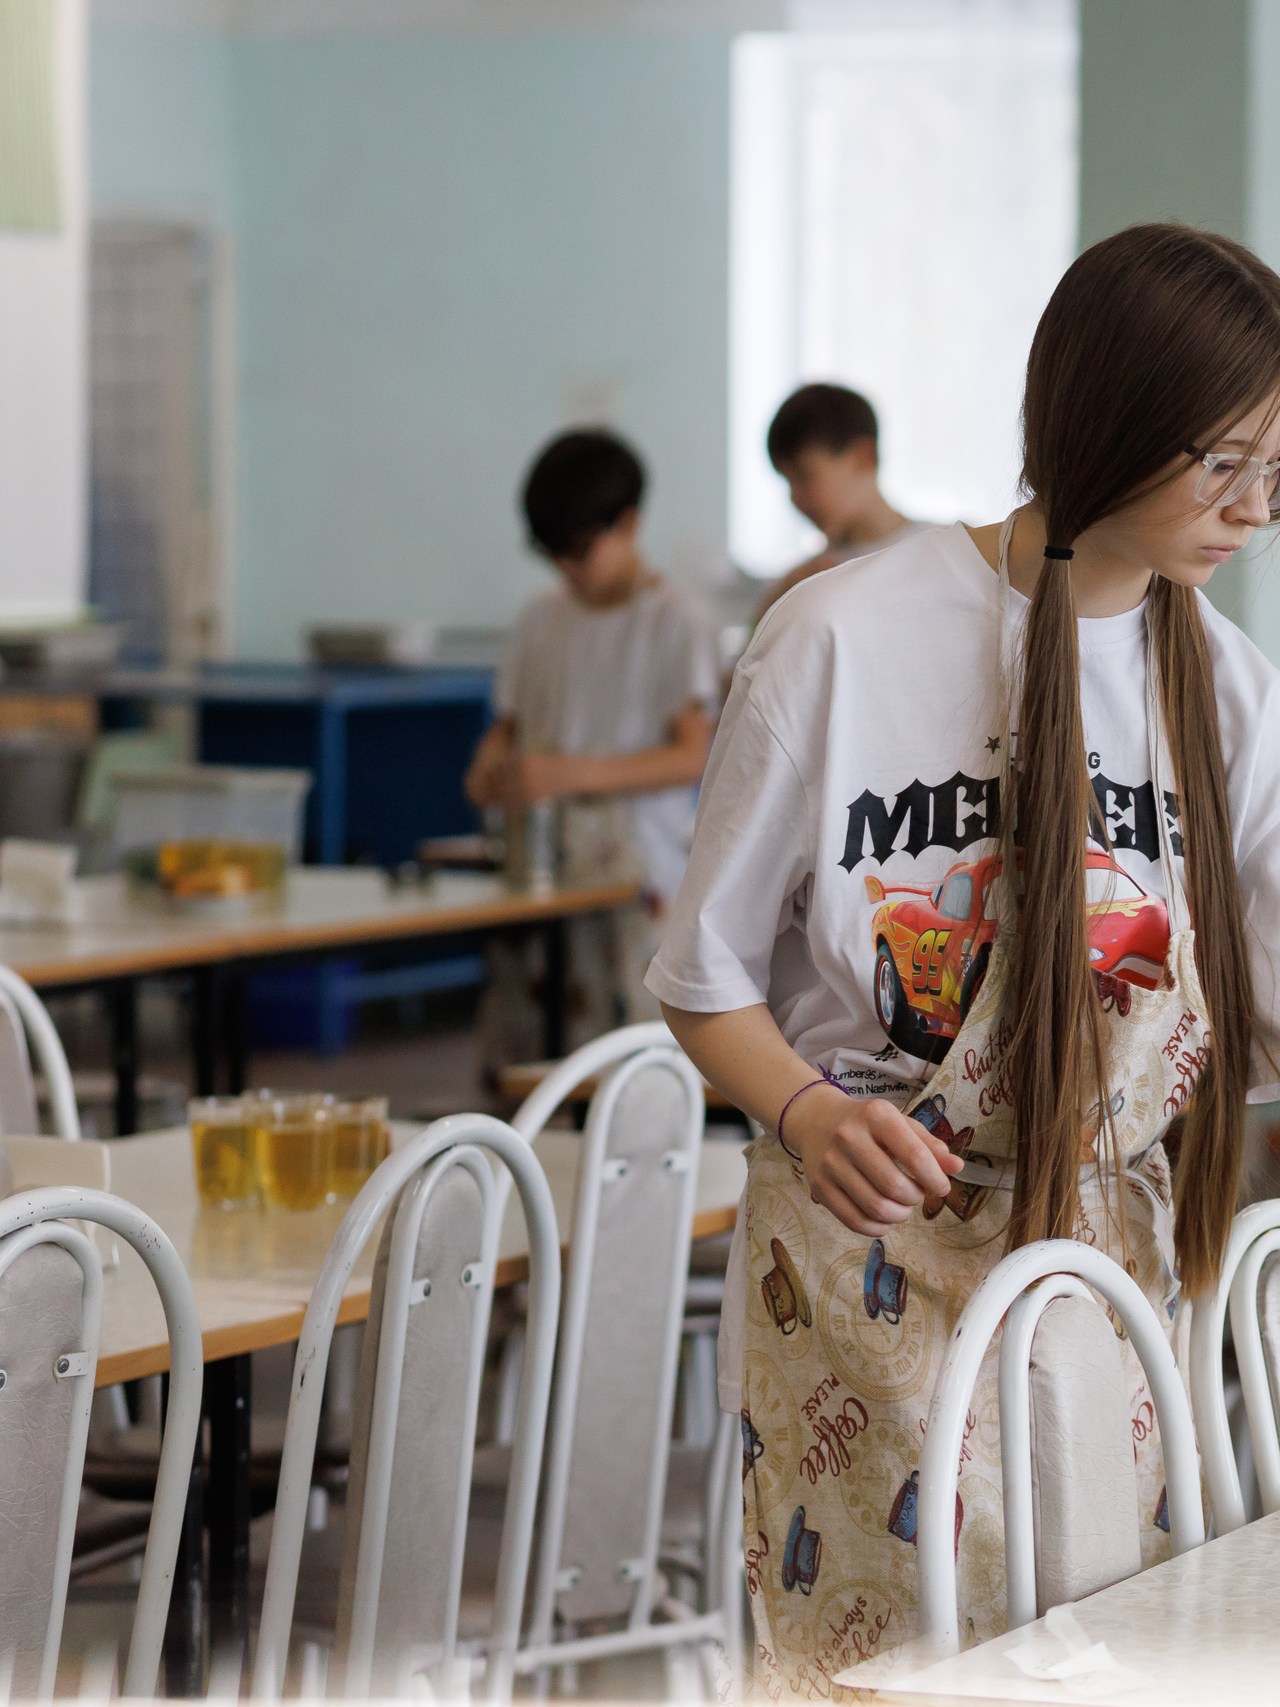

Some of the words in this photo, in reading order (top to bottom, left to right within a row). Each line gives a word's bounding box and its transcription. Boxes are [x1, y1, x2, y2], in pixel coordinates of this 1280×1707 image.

[912, 928, 953, 996] 95
[1161, 1008, 1198, 1062] PLEASE
[801, 1372, 841, 1421] PLEASE
[828, 1596, 868, 1650] always
